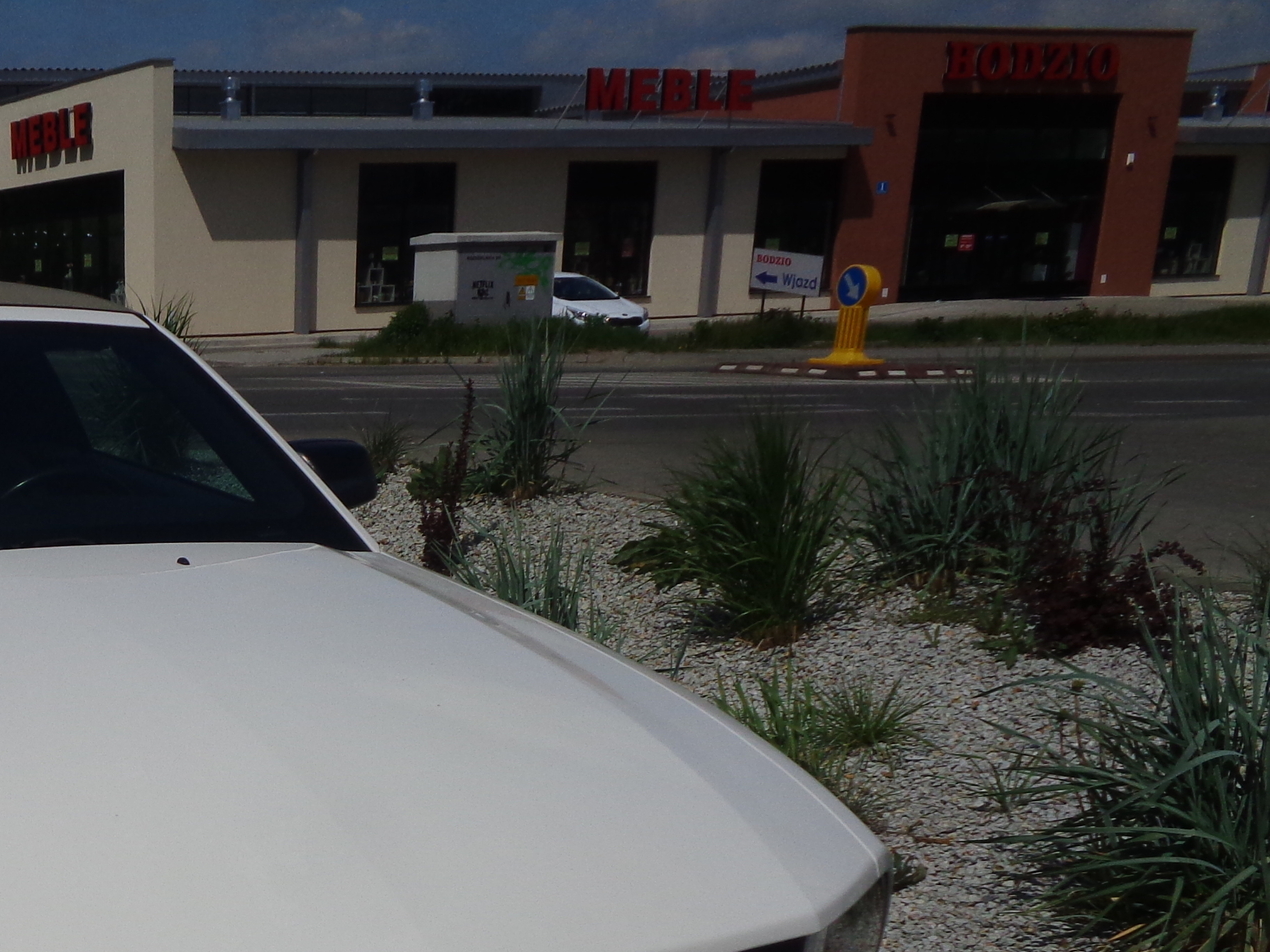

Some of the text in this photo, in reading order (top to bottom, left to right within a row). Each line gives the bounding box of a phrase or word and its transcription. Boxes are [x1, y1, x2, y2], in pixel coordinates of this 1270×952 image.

[946, 40, 1121, 82] BODZIO
[585, 67, 756, 111] MEBLE
[10, 102, 91, 160] MEBLE
[756, 254, 792, 267] BODZIO
[783, 272, 818, 290] Wjazd
